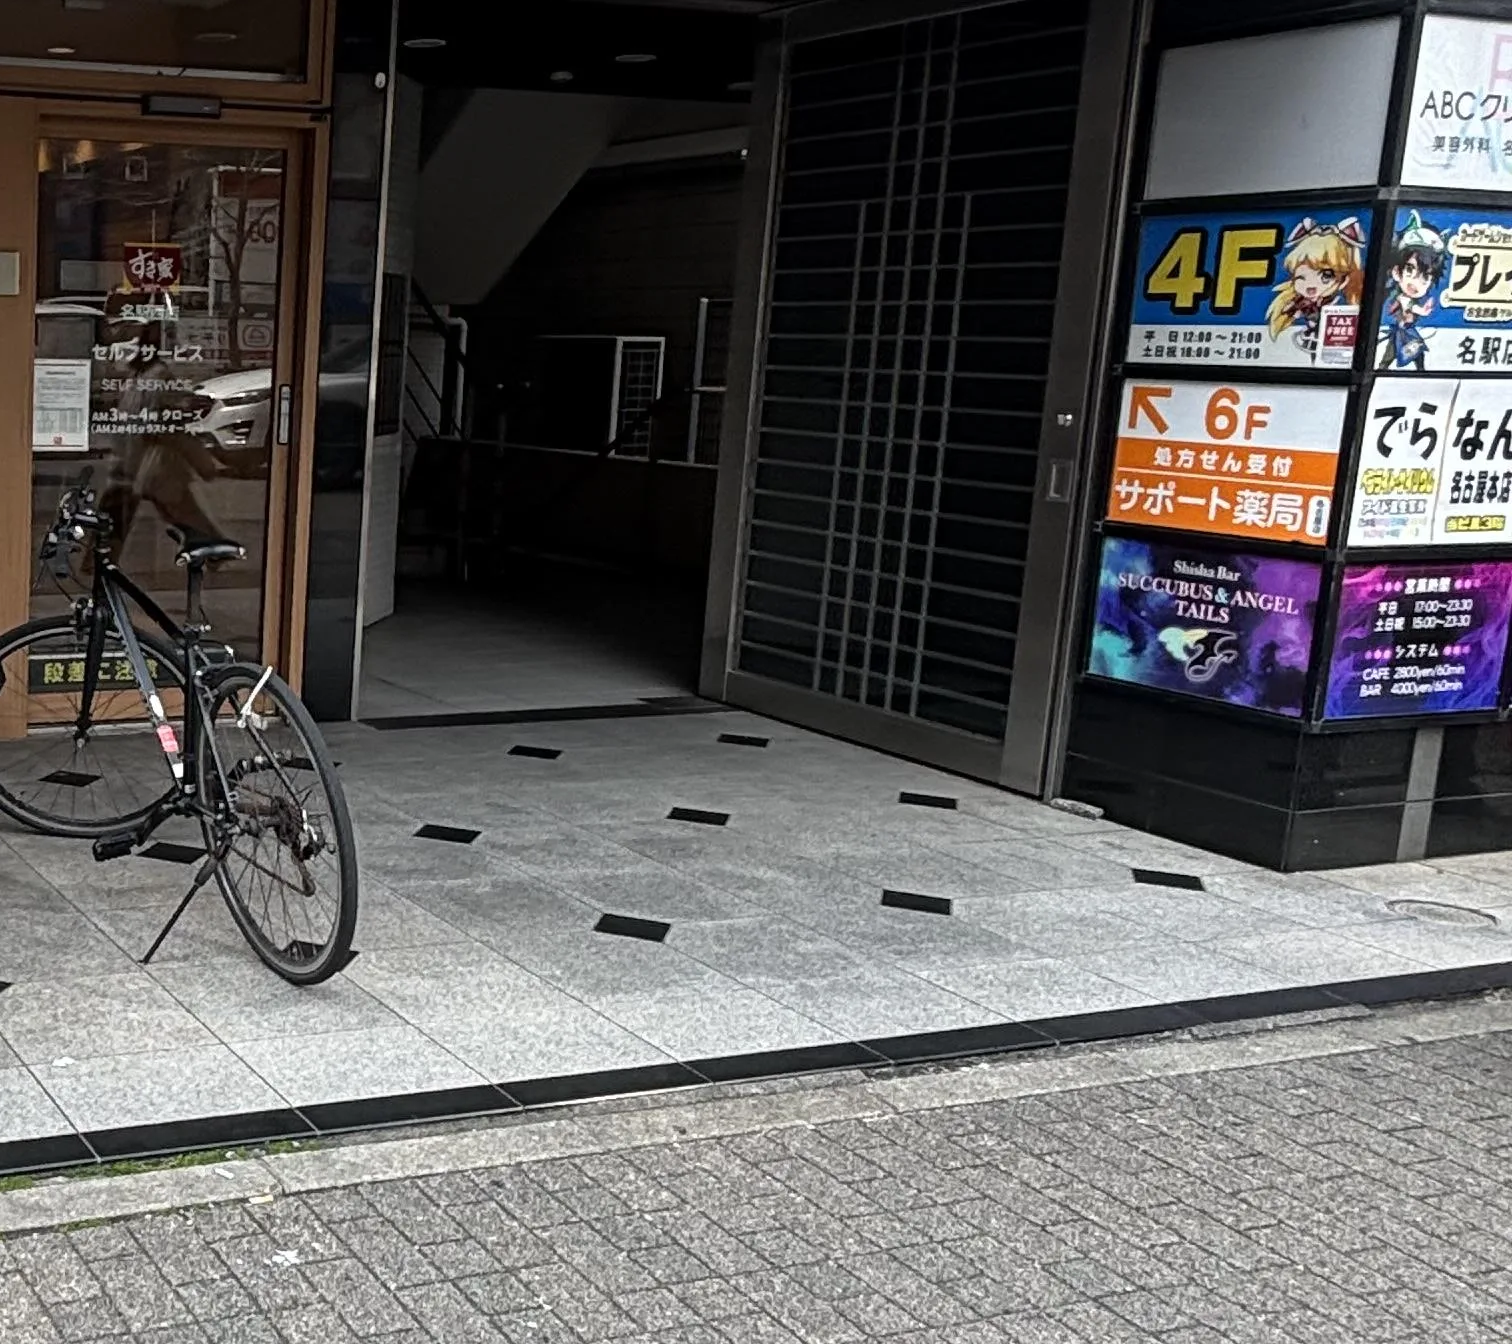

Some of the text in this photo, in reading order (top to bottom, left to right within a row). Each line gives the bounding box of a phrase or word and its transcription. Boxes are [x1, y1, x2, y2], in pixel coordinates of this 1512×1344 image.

[128, 248, 174, 282] すき家
[1147, 228, 1277, 308] 4F
[1452, 253, 1512, 294] プレ
[91, 343, 204, 362] セルフサービス
[1205, 387, 1272, 441] 6F
[1373, 401, 1438, 460] でら
[1153, 446, 1293, 477] 処方せん受付
[1114, 478, 1304, 532] サポート薬局
[1173, 559, 1241, 582] Shisha Bar
[1119, 572, 1299, 615] SUCCUBUS & ANGEL
[1378, 602, 1398, 615] 平日
[1175, 600, 1230, 624] TAILS
[1395, 644, 1438, 658] システム
[1362, 668, 1390, 681] CAFE
[1359, 684, 1381, 697] BAR
